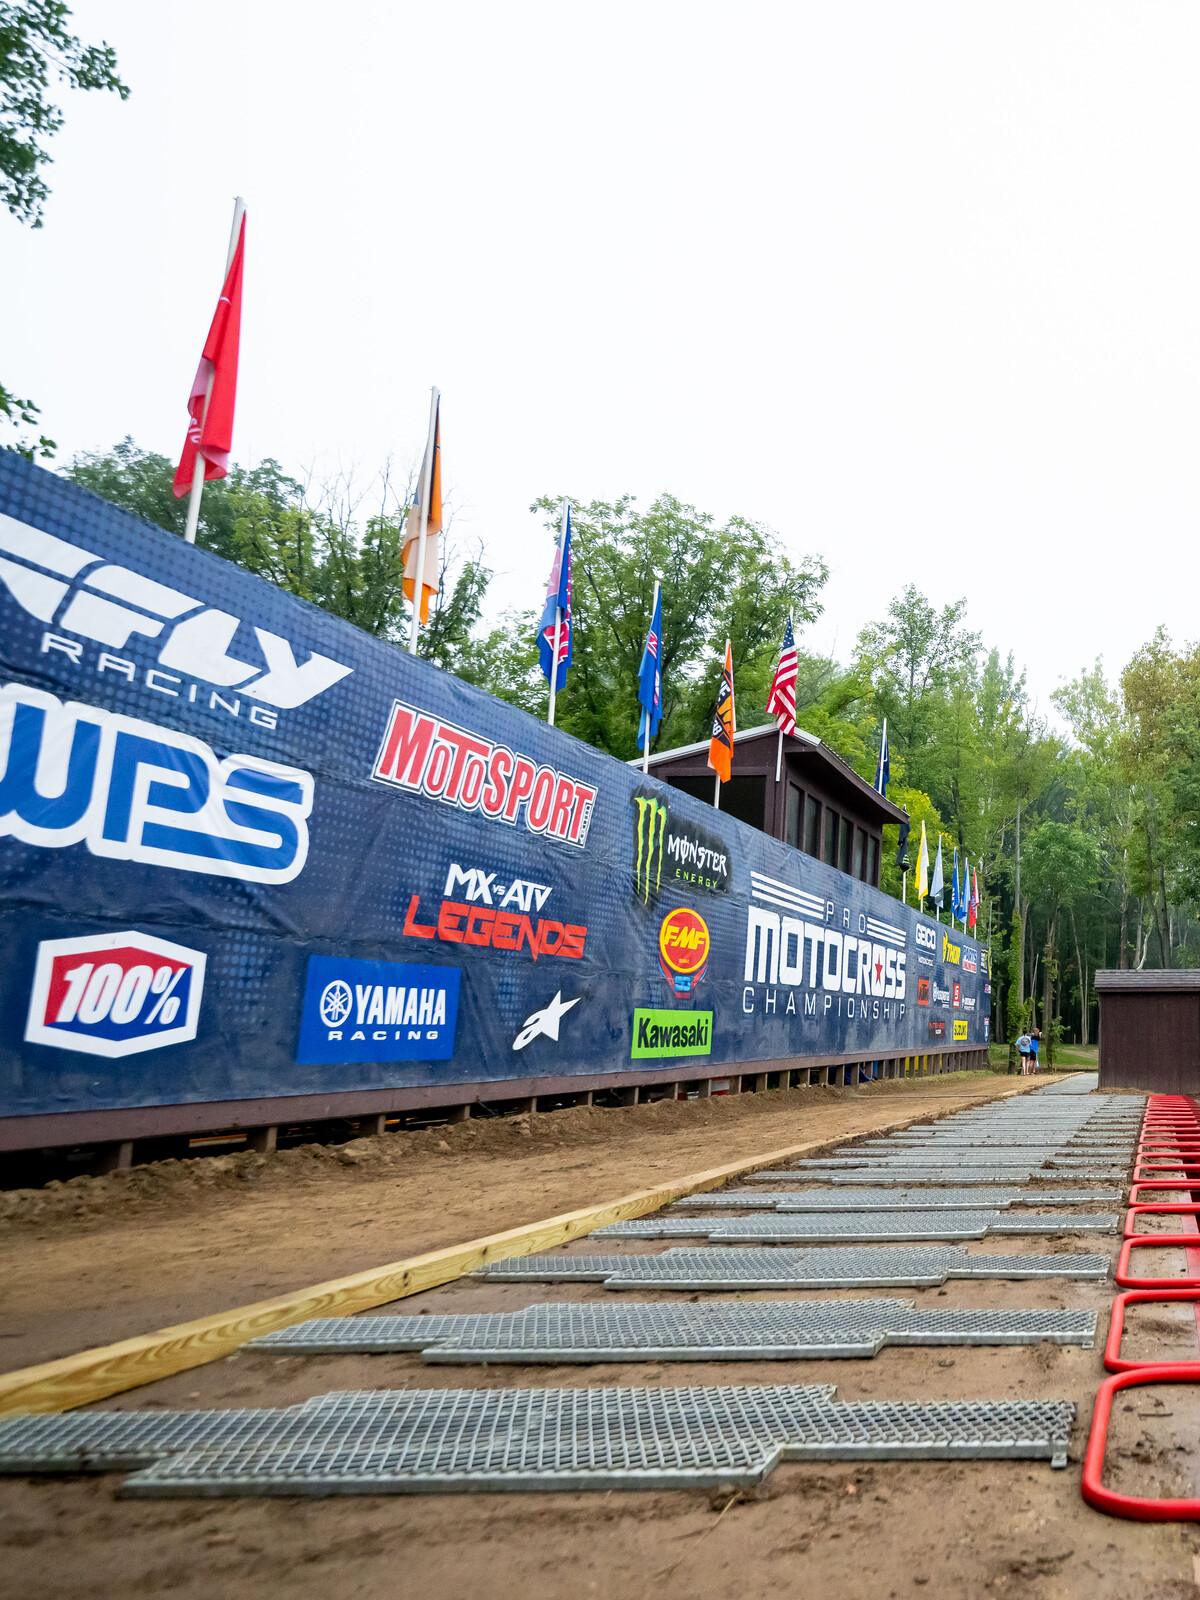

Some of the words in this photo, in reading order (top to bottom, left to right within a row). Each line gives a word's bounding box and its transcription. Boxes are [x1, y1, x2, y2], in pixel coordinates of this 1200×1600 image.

[60, 564, 355, 710] FLY
[41, 632, 279, 730] RACING
[443, 863, 498, 905] MX
[499, 879, 553, 913] ATV
[675, 868, 717, 889] ENERGY
[402, 894, 588, 964] LEGENDS
[826, 900, 867, 934] PRO
[664, 924, 706, 950] FMF
[744, 904, 907, 1000] MOTOCROSS
[915, 922, 937, 950] GEICO
[55, 962, 181, 1025] 100%
[355, 984, 446, 1025] YAMAHA
[742, 986, 906, 1020] CHAMPIONSHIP
[327, 1030, 439, 1041] RACING
[637, 1017, 709, 1049] Kawasaki
